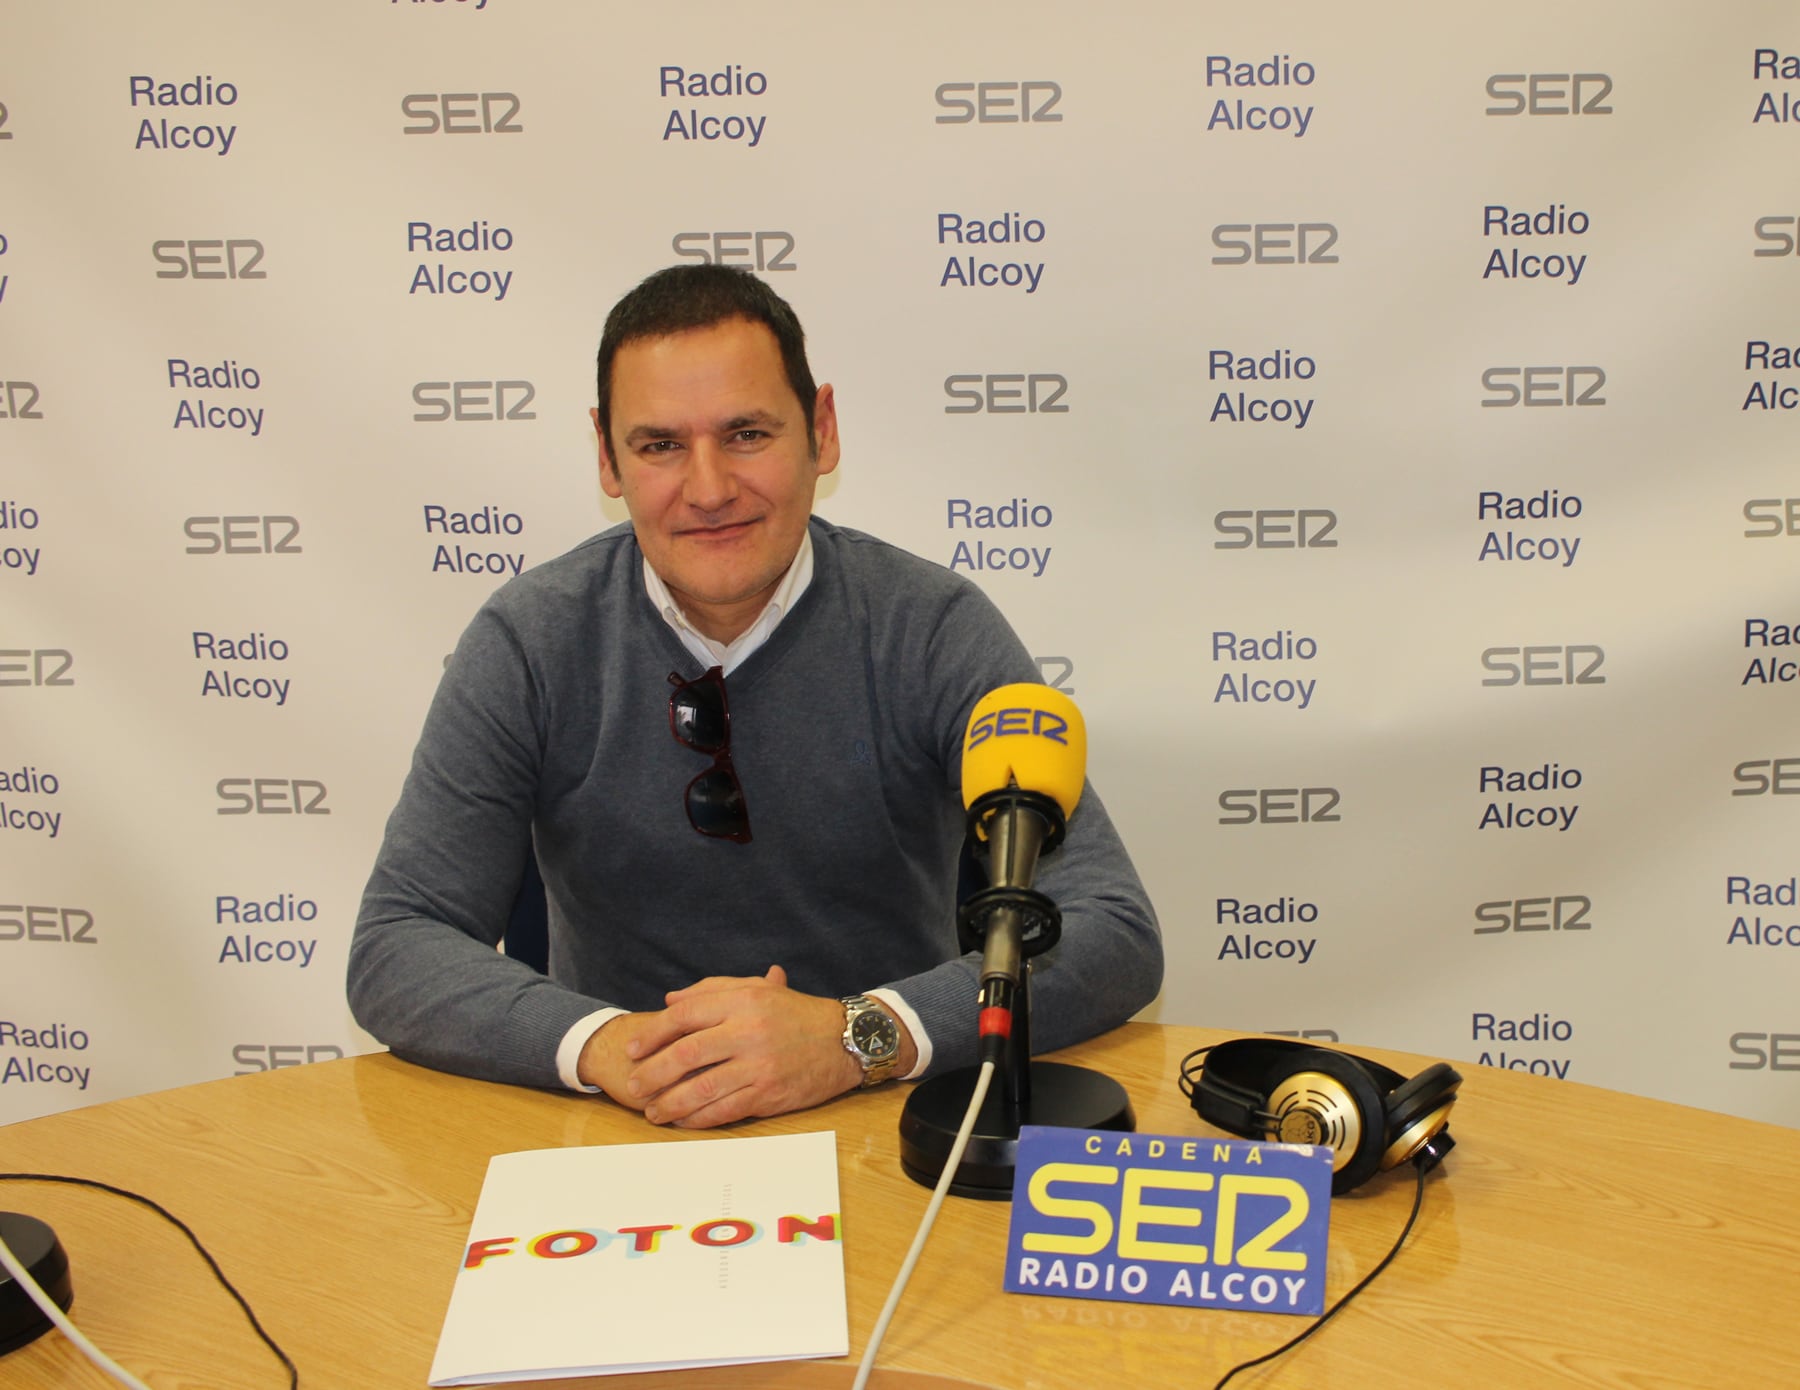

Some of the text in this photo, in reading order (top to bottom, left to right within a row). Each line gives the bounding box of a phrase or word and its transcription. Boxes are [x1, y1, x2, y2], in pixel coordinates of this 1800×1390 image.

[660, 65, 767, 97] Radio
[1207, 55, 1315, 87] Radio
[130, 76, 237, 106] Radio
[935, 82, 1062, 124] SER
[1486, 74, 1612, 115] SER
[402, 93, 523, 134] SER
[663, 109, 766, 147] Alcoy
[1207, 99, 1313, 137] Alcoy
[136, 119, 237, 156] Alcoy
[408, 221, 513, 252] Radio
[938, 212, 1045, 244] Radio
[1484, 204, 1589, 236] Radio
[153, 240, 266, 279] SER
[672, 231, 797, 271] SER
[1212, 224, 1339, 264] SER
[409, 264, 513, 301] Alcoy
[940, 256, 1044, 293] Alcoy
[1483, 248, 1587, 285] Alcoy
[168, 359, 260, 389] Radio
[1209, 350, 1315, 380] Radio
[413, 381, 536, 421] SER
[944, 374, 1069, 413] SER
[1482, 367, 1606, 407] SER
[174, 400, 264, 436] Alcoy
[1210, 392, 1314, 429] Alcoy
[424, 505, 523, 535] Radio
[948, 498, 1052, 528] Radio
[1479, 490, 1582, 520] Radio
[184, 516, 302, 554] SER
[1214, 510, 1338, 549] SER
[432, 545, 525, 576] Alcoy
[949, 541, 1052, 577] Alcoy
[1479, 531, 1580, 567] Alcoy
[193, 632, 288, 660] Radio
[1213, 631, 1317, 661] Radio
[0, 649, 74, 686] ER
[1482, 645, 1605, 686] SER
[202, 670, 290, 706] Alcoy
[1214, 673, 1316, 709] Alcoy
[968, 708, 1068, 751] SER
[0, 767, 59, 794] adio
[1480, 763, 1582, 793] Radio
[1732, 758, 1800, 796] SE
[217, 779, 330, 814] SER
[1219, 788, 1340, 824] SER
[0, 802, 61, 838] lcoy
[1479, 802, 1579, 831] Alcoy
[216, 894, 317, 924] Radio
[1727, 877, 1797, 906] Rad
[1217, 897, 1318, 924] Radio
[1474, 896, 1591, 934] SER
[1218, 934, 1316, 964] Alcoy
[1727, 917, 1800, 946] Alco
[219, 935, 317, 968] Alcoy
[0, 1021, 88, 1050] Radio
[1473, 1013, 1572, 1041] Radio
[1729, 1033, 1800, 1070] SE
[1, 1057, 90, 1090] Alcoy
[1085, 1136, 1263, 1165] CADENA
[1022, 1162, 1310, 1271] SER
[462, 1214, 841, 1271] FOTON
[1019, 1257, 1306, 1306] RADIO ALCOY
